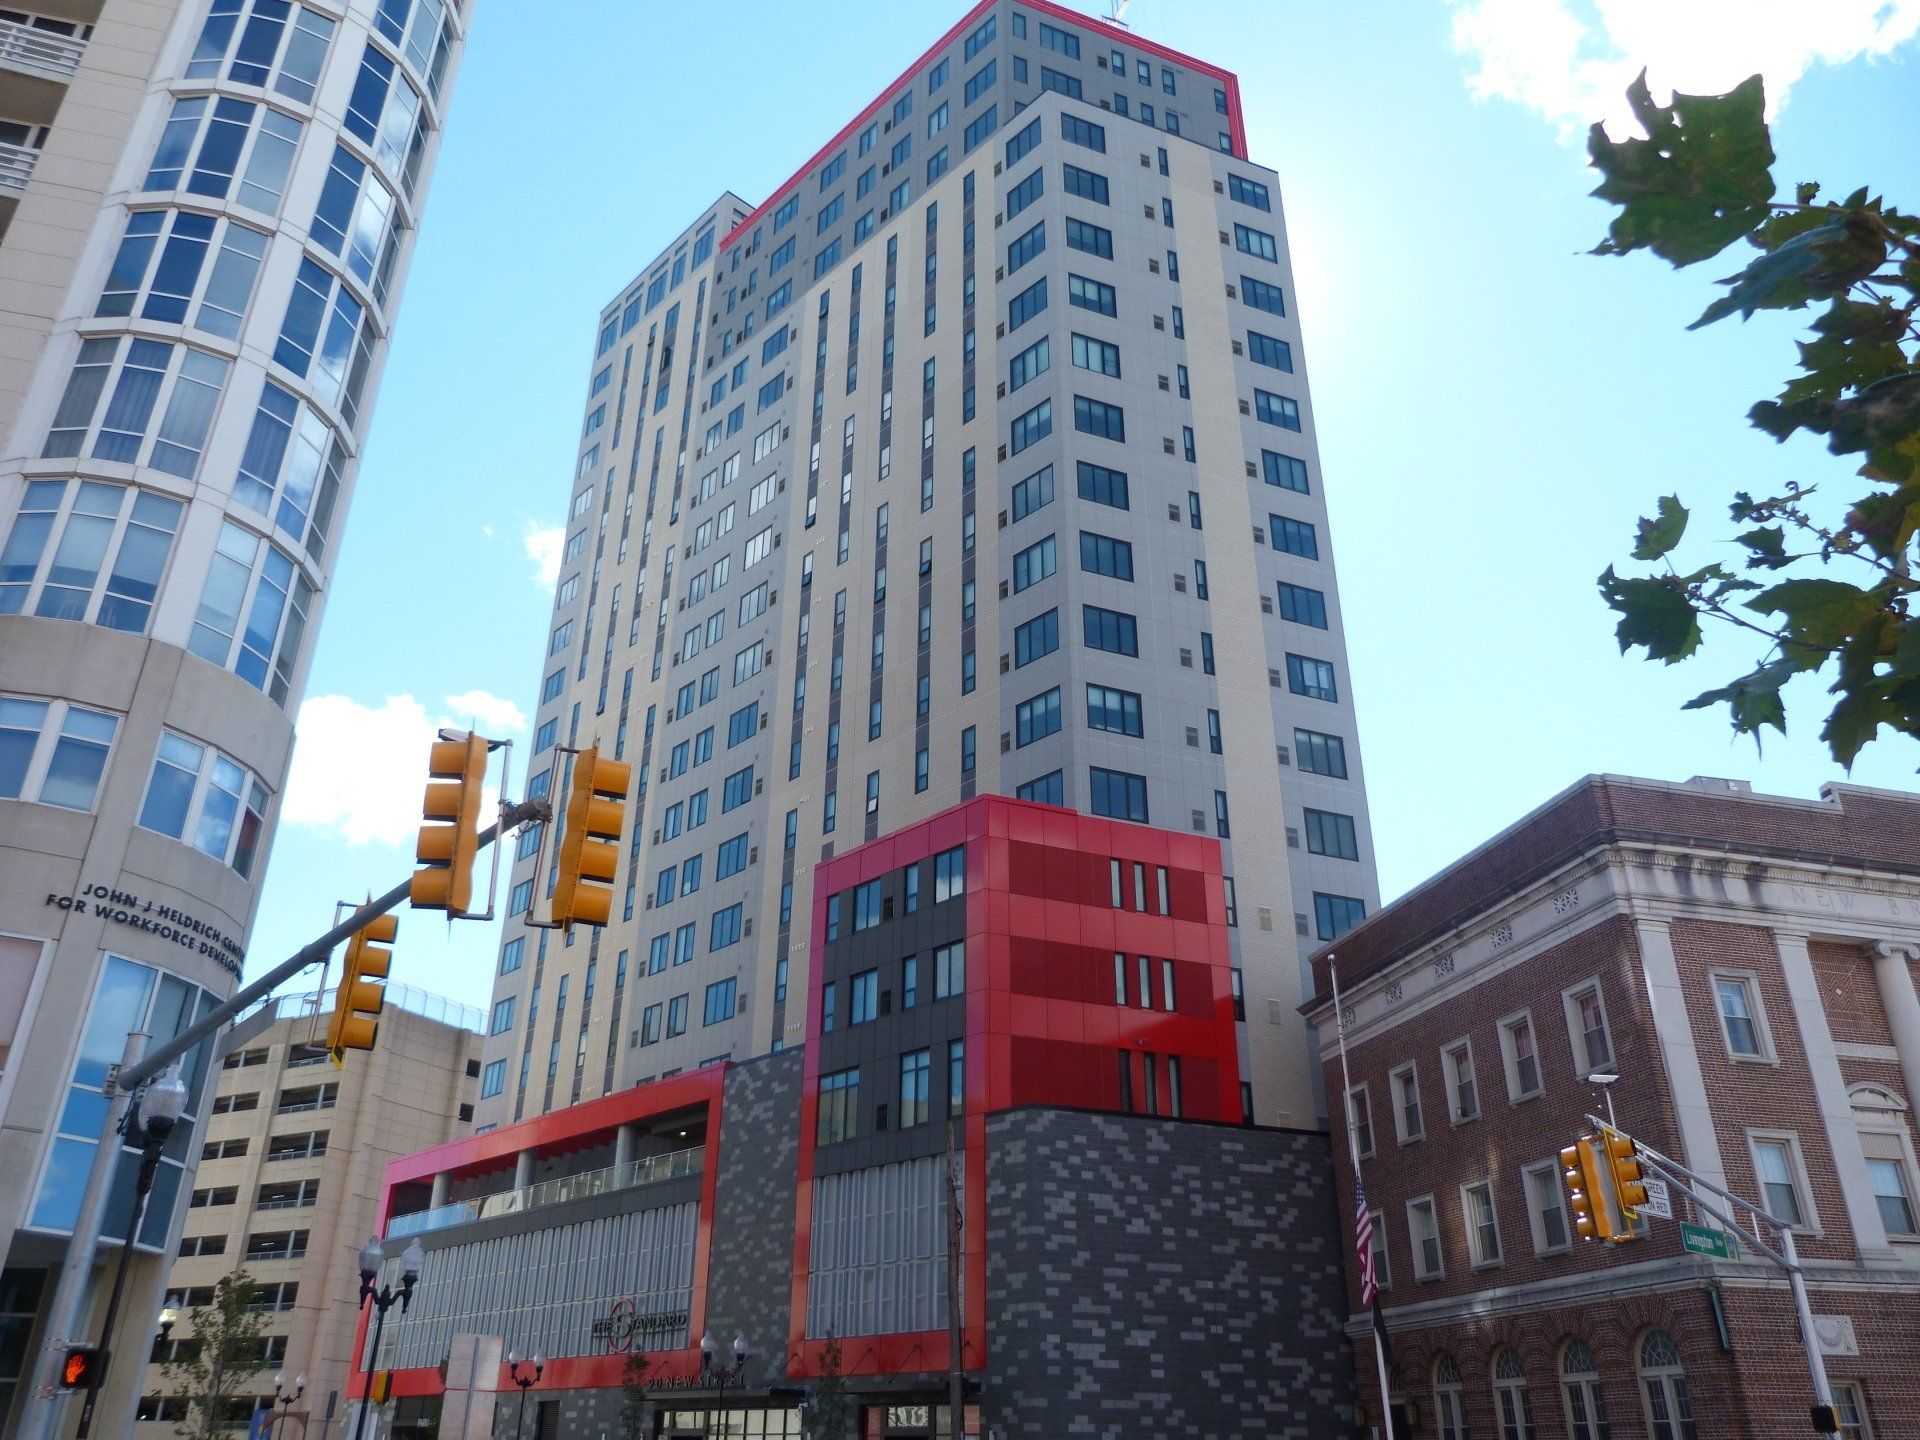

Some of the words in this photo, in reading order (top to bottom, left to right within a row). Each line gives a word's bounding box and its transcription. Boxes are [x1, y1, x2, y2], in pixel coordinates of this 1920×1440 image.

[1791, 886, 1855, 909] NEW
[46, 894, 87, 913] FOR
[95, 904, 195, 950] WORKFORCE
[82, 883, 138, 908] JOHN
[158, 905, 220, 943] HELDRICH
[611, 1312, 687, 1338] STANDARD
[665, 1375, 695, 1389] NEW
